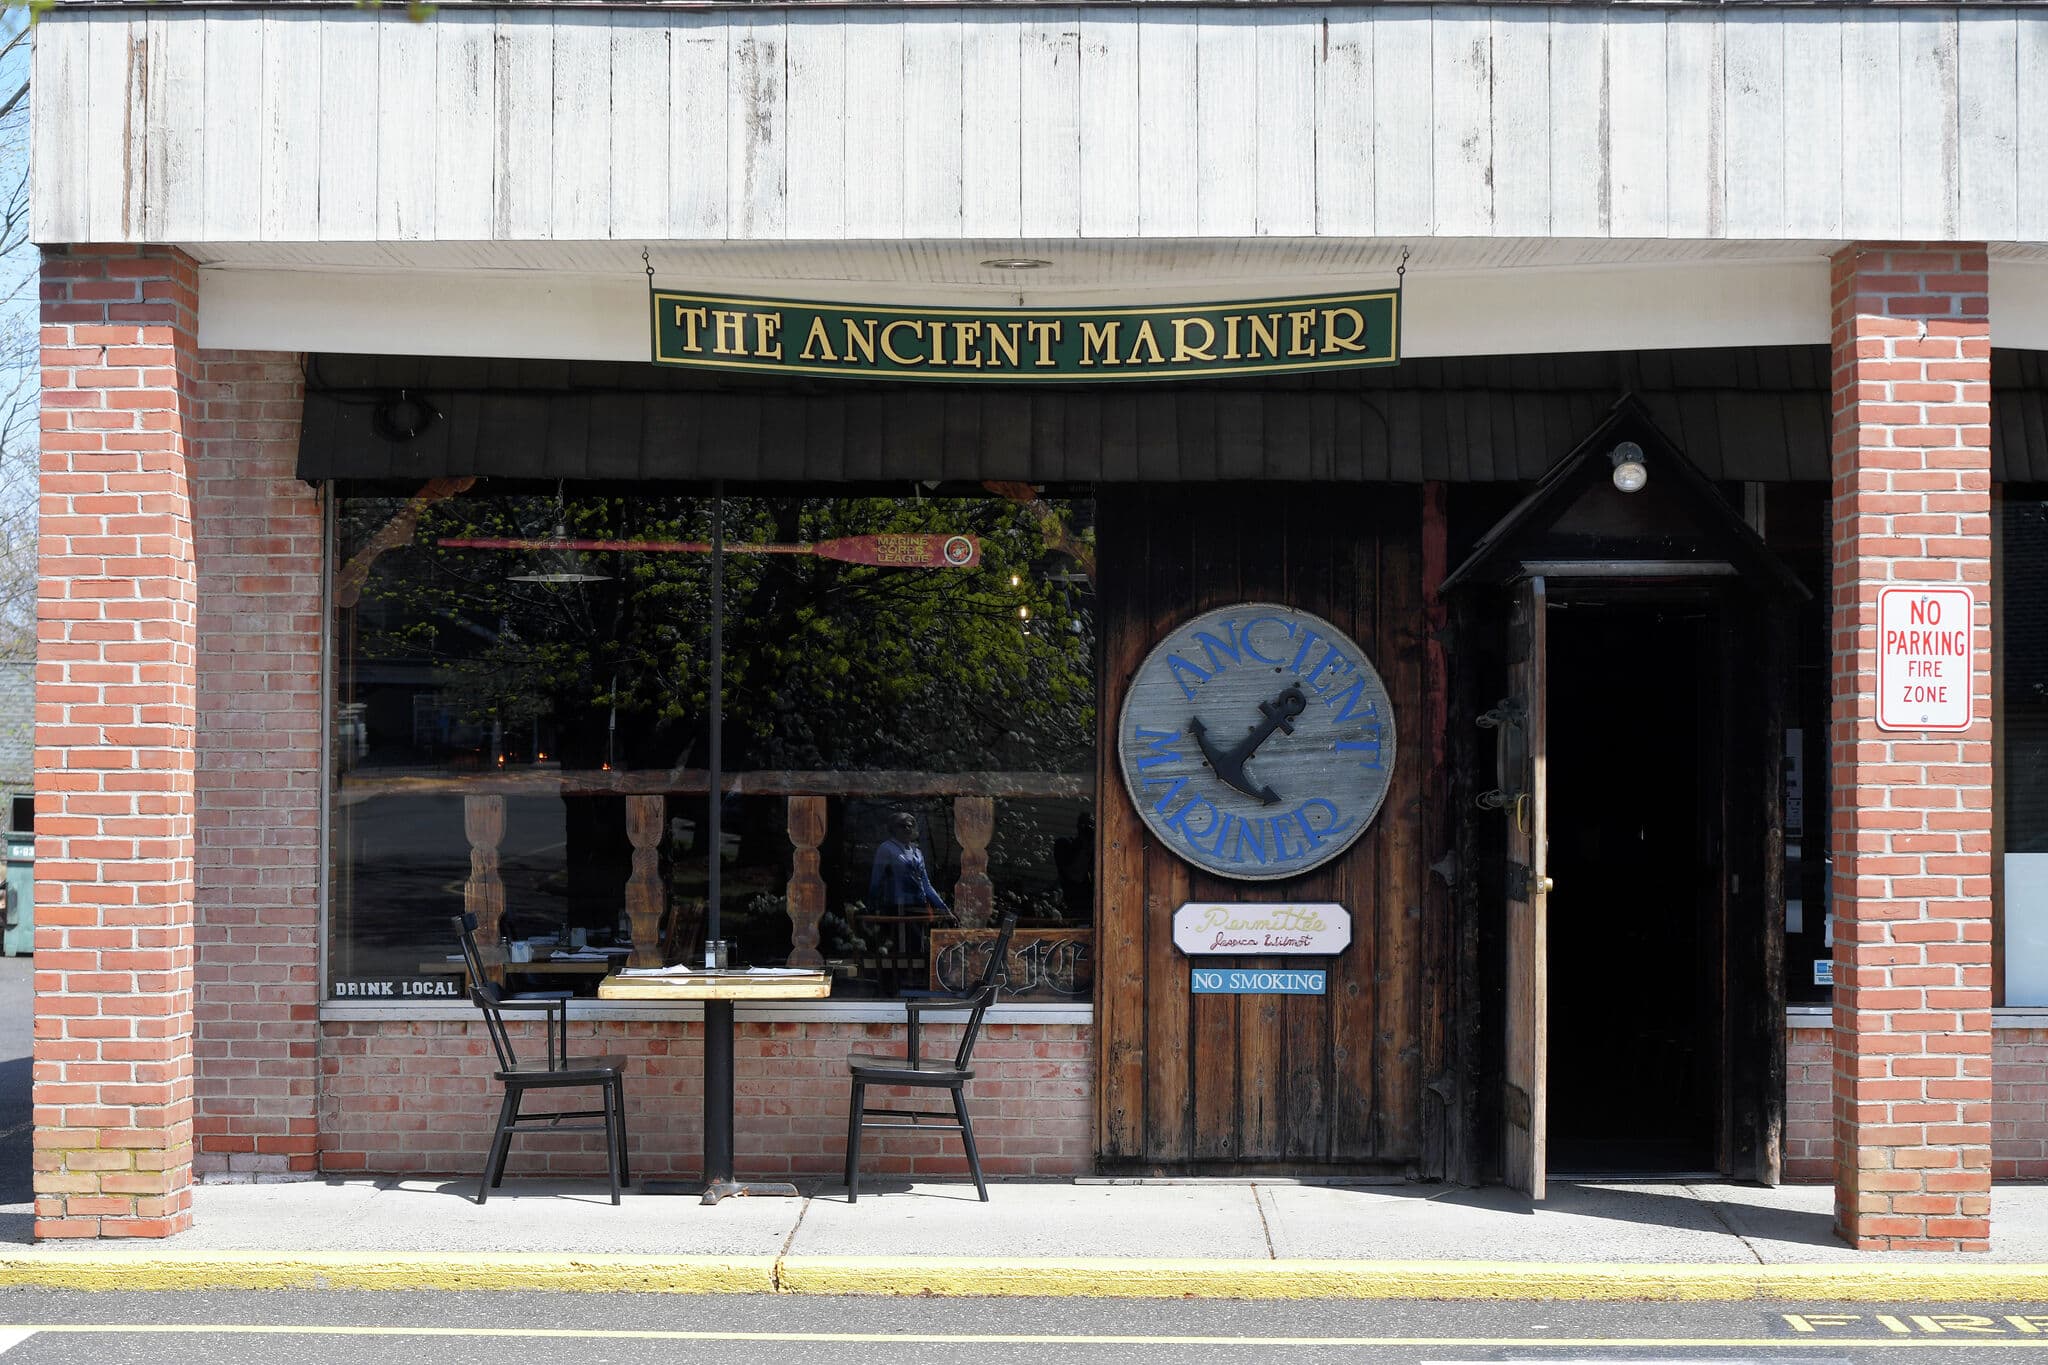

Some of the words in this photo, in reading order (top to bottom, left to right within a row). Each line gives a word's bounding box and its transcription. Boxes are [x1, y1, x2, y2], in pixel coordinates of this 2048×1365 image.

[675, 305, 782, 361] THE
[799, 315, 1062, 368] ANCIENT
[1079, 307, 1367, 366] MARINER
[877, 536, 929, 546] MARINE
[877, 545, 925, 555] CORPS
[877, 554, 929, 563] LEAGUE
[1910, 600, 1942, 626] NO
[1887, 630, 1966, 657] PARKING
[1908, 660, 1943, 678] FIRE
[1166, 616, 1385, 772] ANCIENT
[1902, 685, 1948, 703] ZONE
[1135, 723, 1356, 865] MARINER
[1210, 931, 1259, 951] Jessica
[335, 981, 395, 996] DRINK
[402, 981, 459, 996] LOCAL
[1194, 972, 1223, 989] NO
[1229, 972, 1324, 990] SMOKING
